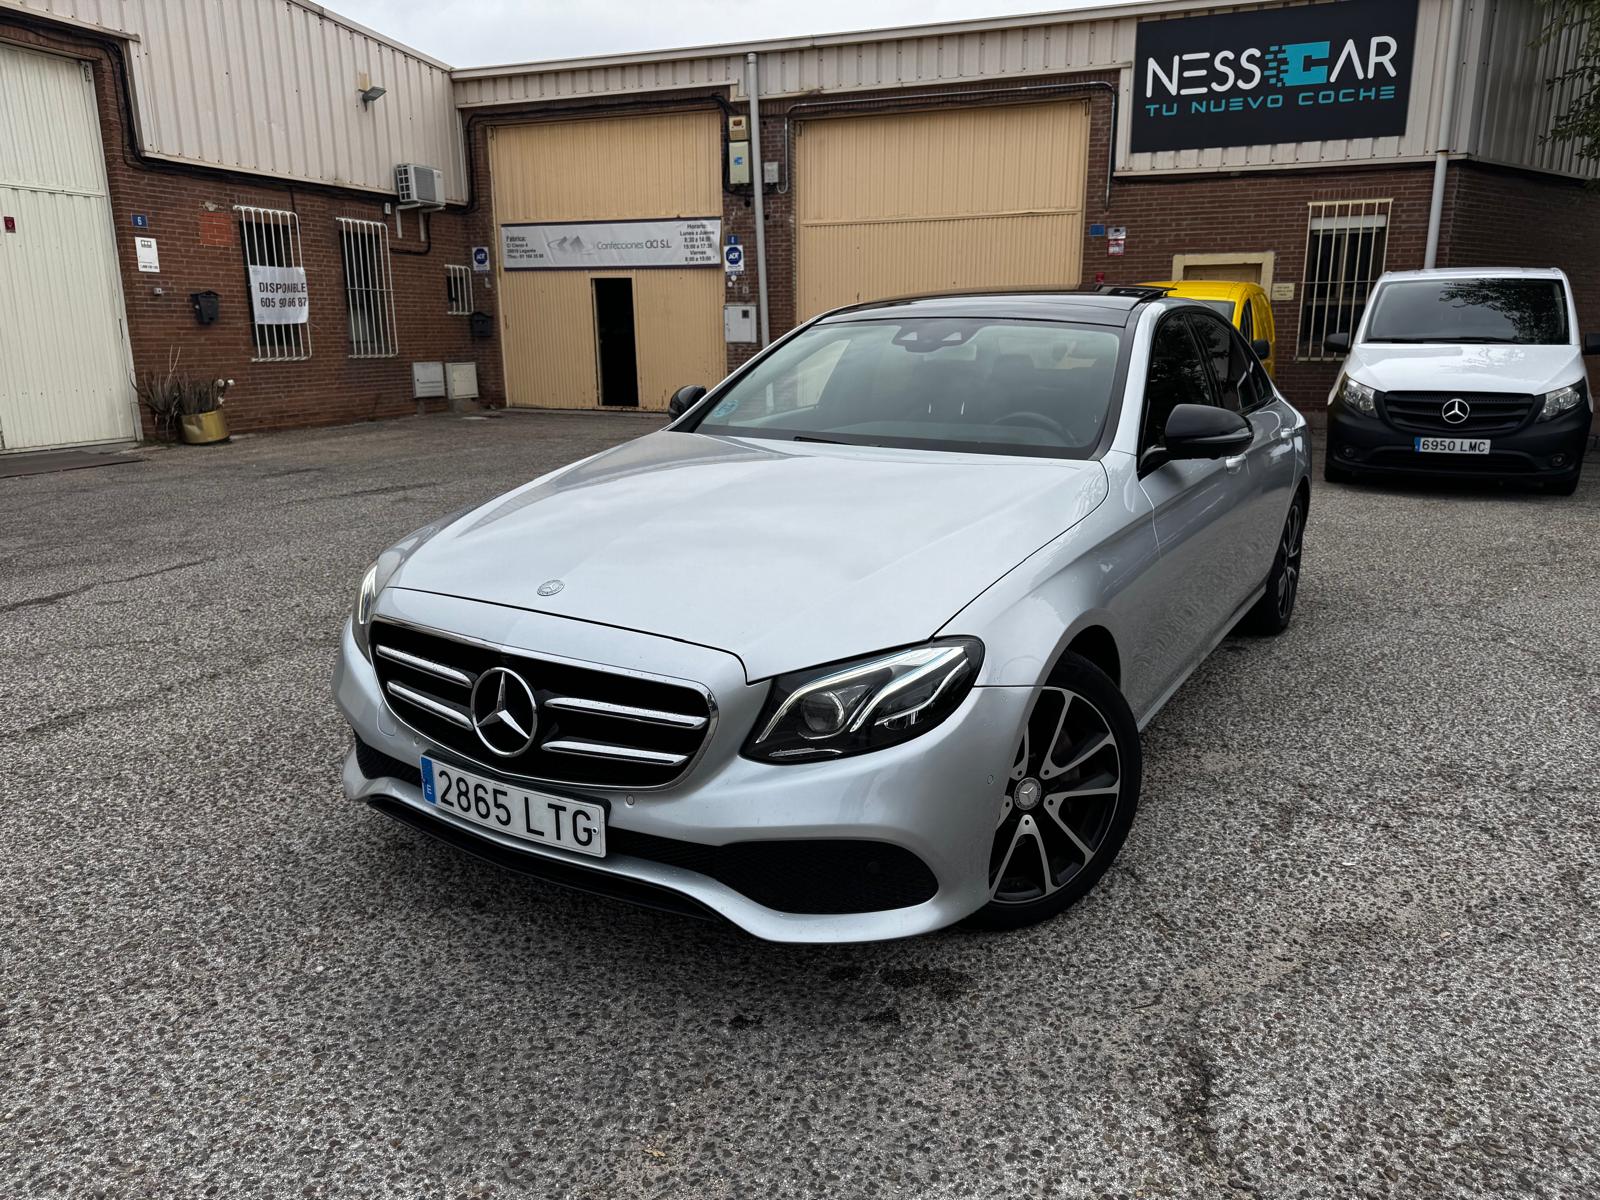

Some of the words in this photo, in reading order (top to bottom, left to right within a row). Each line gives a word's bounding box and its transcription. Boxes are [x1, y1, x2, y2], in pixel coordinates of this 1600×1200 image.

[1145, 103, 1178, 117] TU
[1192, 95, 1283, 114] NUEVO
[1298, 86, 1396, 106] COCHE
[137, 216, 142, 225] 6
[597, 241, 644, 250] Confecciones
[260, 298, 276, 308] 605
[298, 297, 307, 307] 87
[1422, 440, 1455, 451] 6950
[1460, 441, 1486, 452] LMC
[438, 770, 511, 826] 2865
[524, 796, 594, 847] LTG
